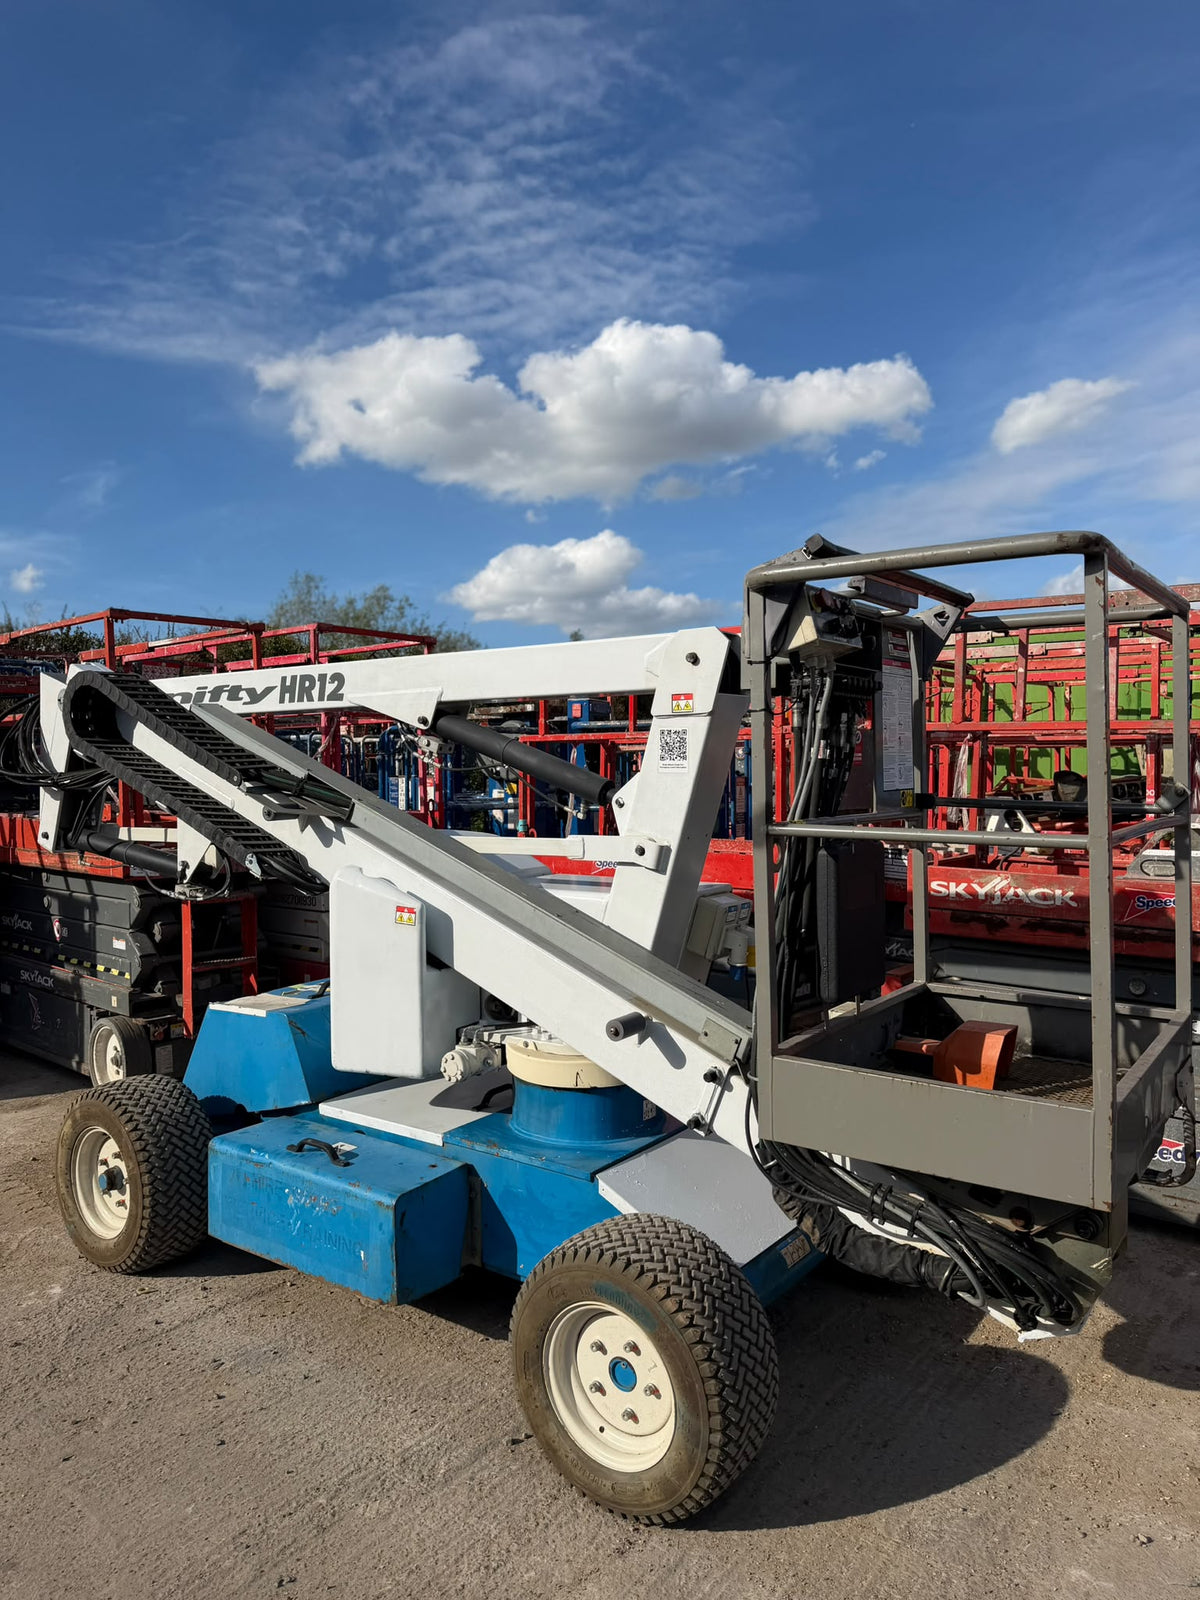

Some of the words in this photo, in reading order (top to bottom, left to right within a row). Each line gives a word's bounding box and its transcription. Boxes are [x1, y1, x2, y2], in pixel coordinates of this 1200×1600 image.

[167, 684, 278, 705] nifty
[279, 672, 346, 704] HR12
[929, 874, 1078, 908] SKYJACK
[1135, 894, 1176, 911] Spee
[1, 914, 33, 931] SKYJACK
[20, 969, 55, 988] SKYJACK
